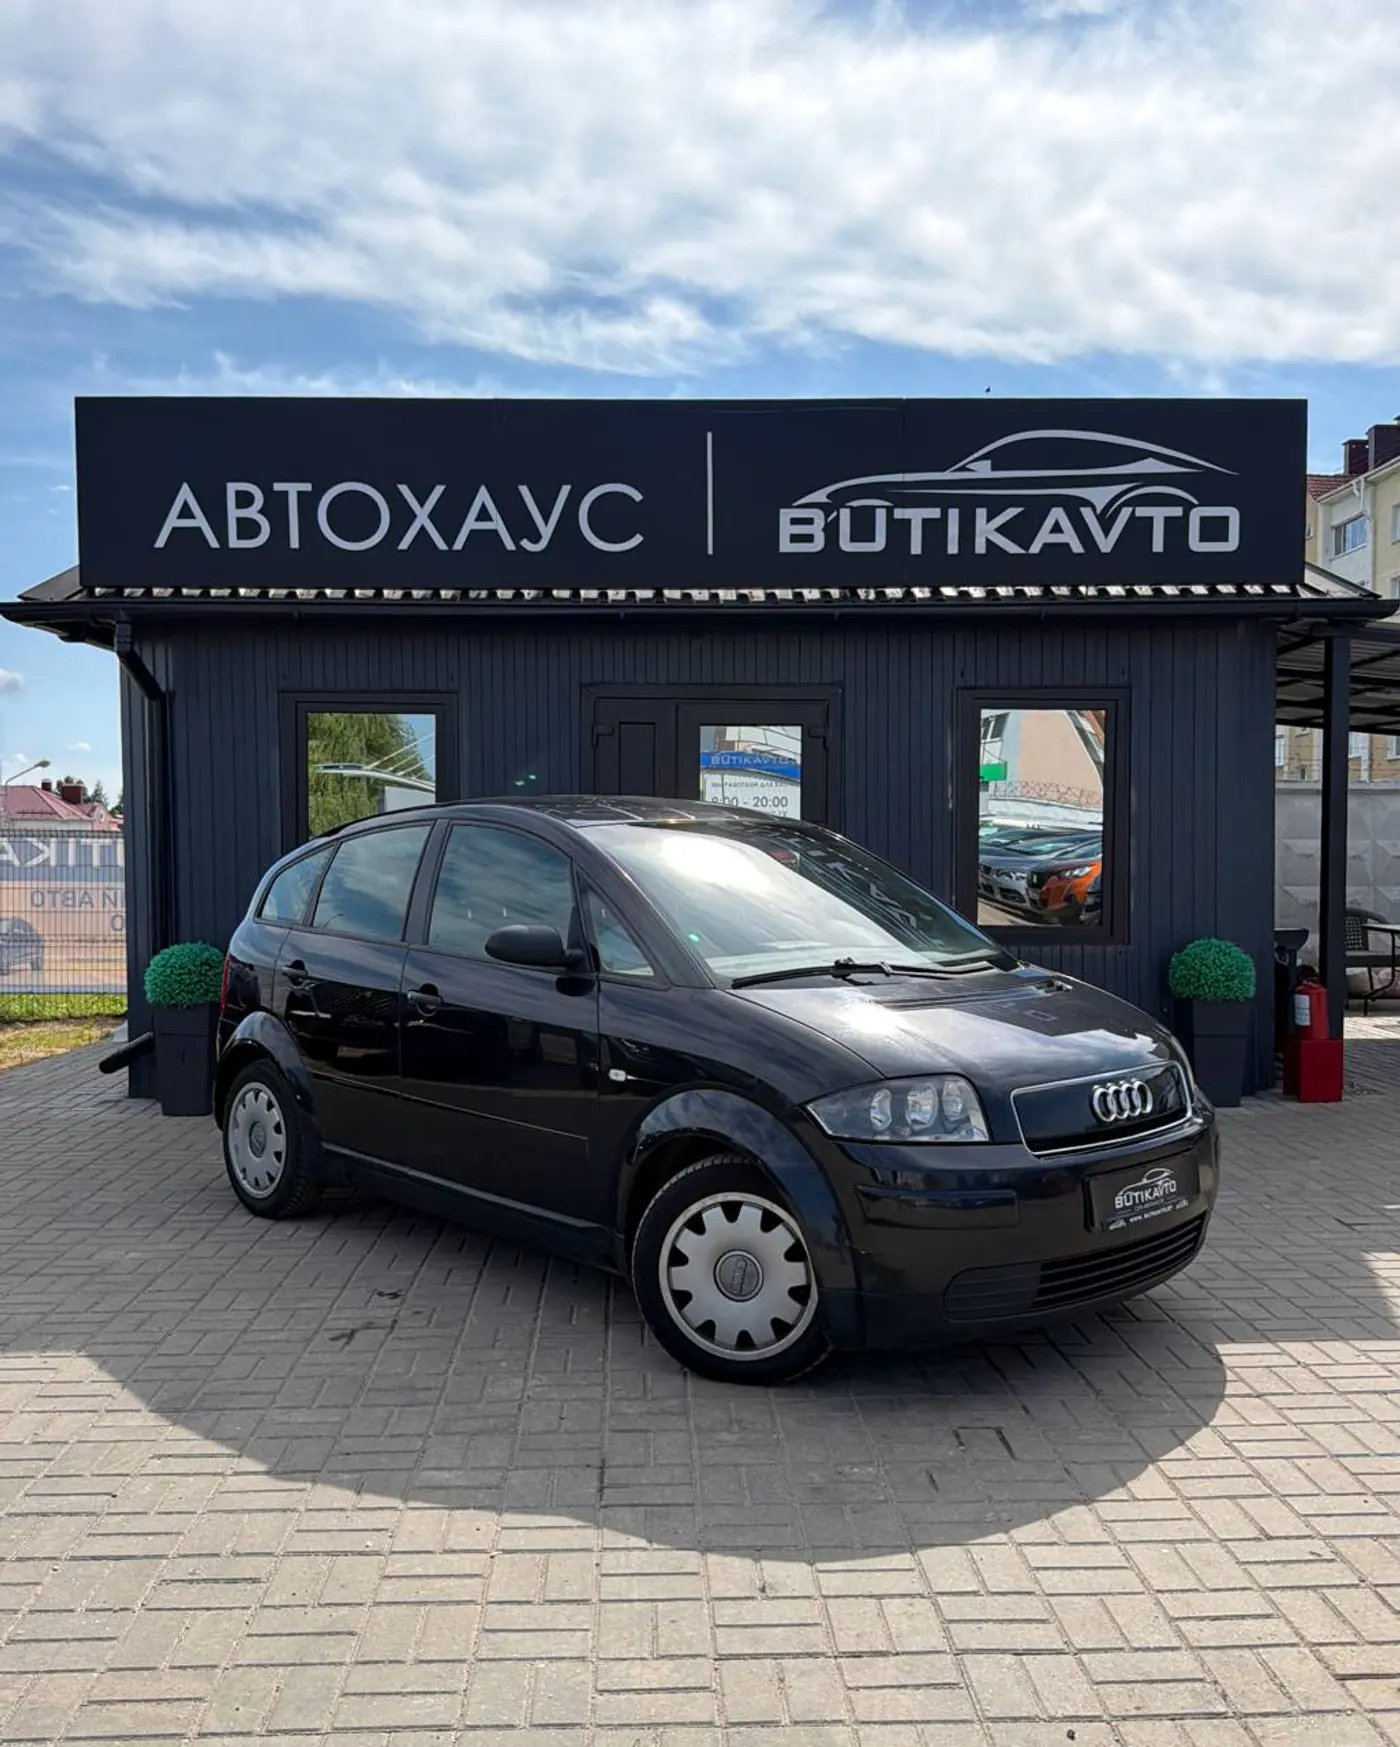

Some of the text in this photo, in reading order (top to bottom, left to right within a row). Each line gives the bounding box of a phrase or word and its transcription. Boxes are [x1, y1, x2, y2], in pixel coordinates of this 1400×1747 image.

[154, 481, 644, 552] АВТОХАУС
[778, 506, 1241, 555] BUTIKAVTO
[753, 796, 789, 808] 20:00
[1114, 1180, 1177, 1209] BUTIKAVTO
